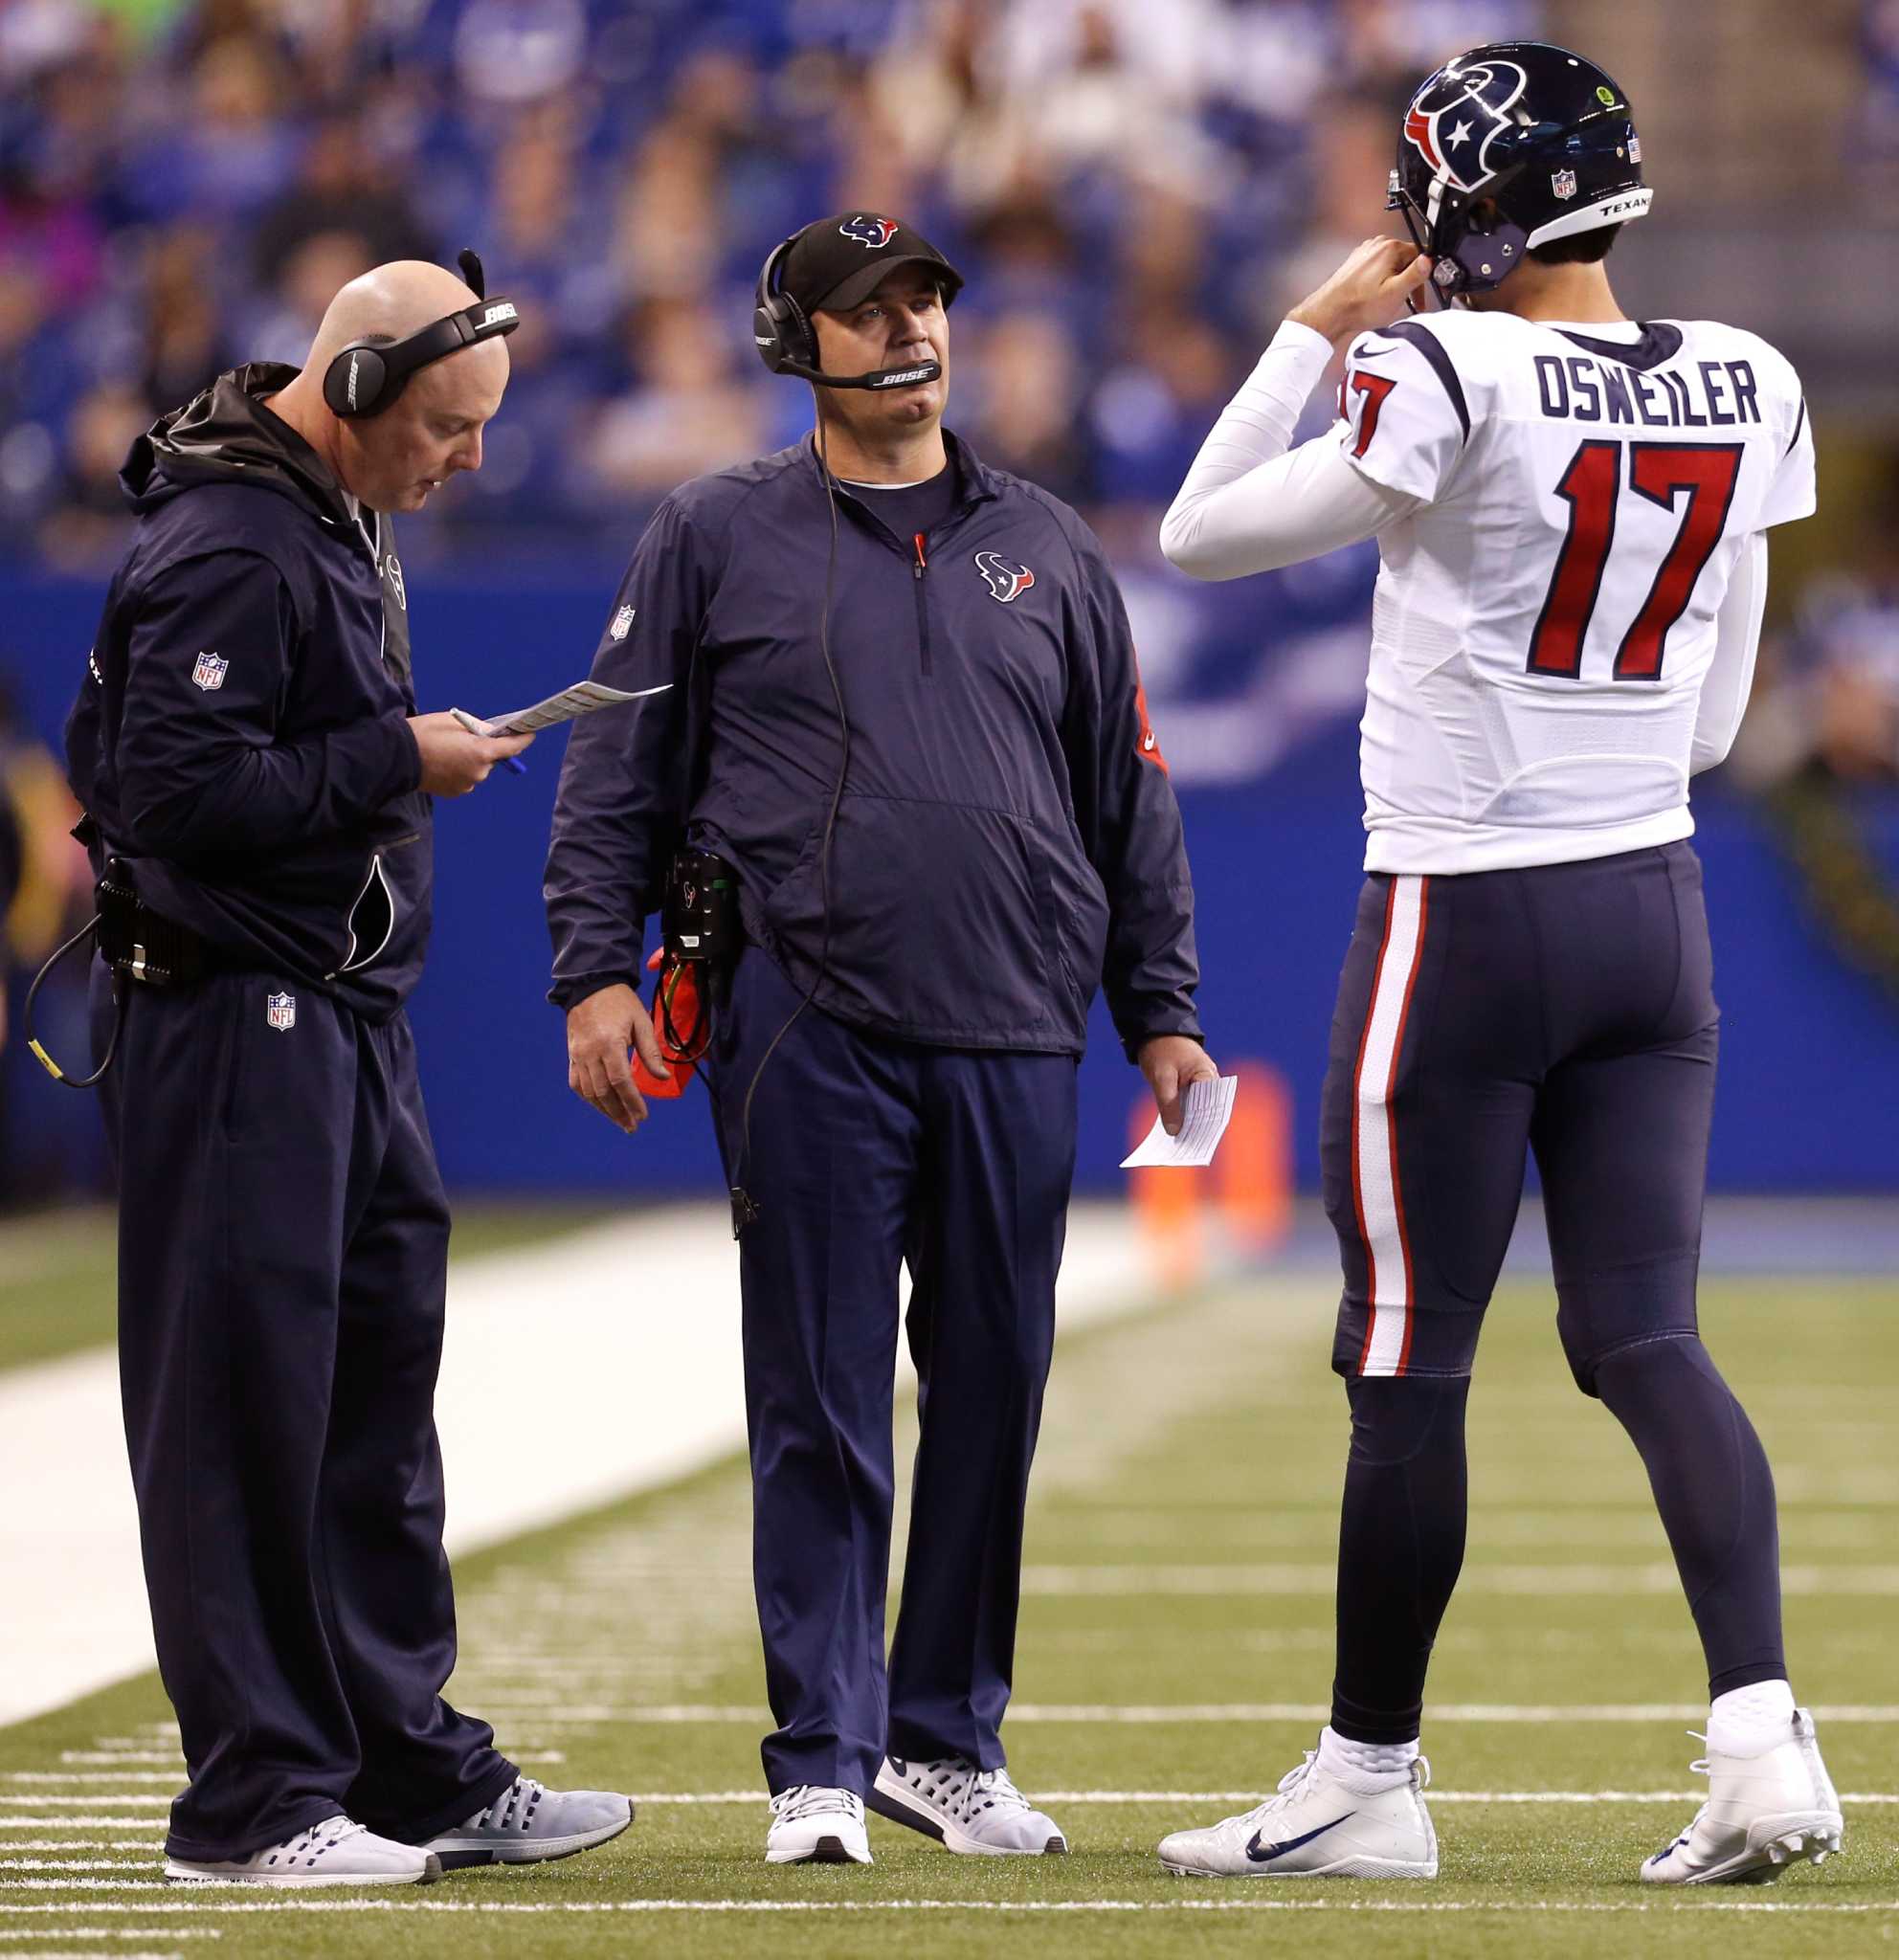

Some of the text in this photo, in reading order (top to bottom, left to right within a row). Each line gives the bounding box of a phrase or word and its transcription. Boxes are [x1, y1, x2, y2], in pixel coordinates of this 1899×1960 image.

[347, 351, 359, 412] BOSE
[873, 367, 934, 387] BOSE
[1533, 355, 1762, 427] OSWEILER
[1526, 438, 1746, 681] 17
[196, 667, 219, 685] NFL
[271, 1008, 293, 1025] NFL
